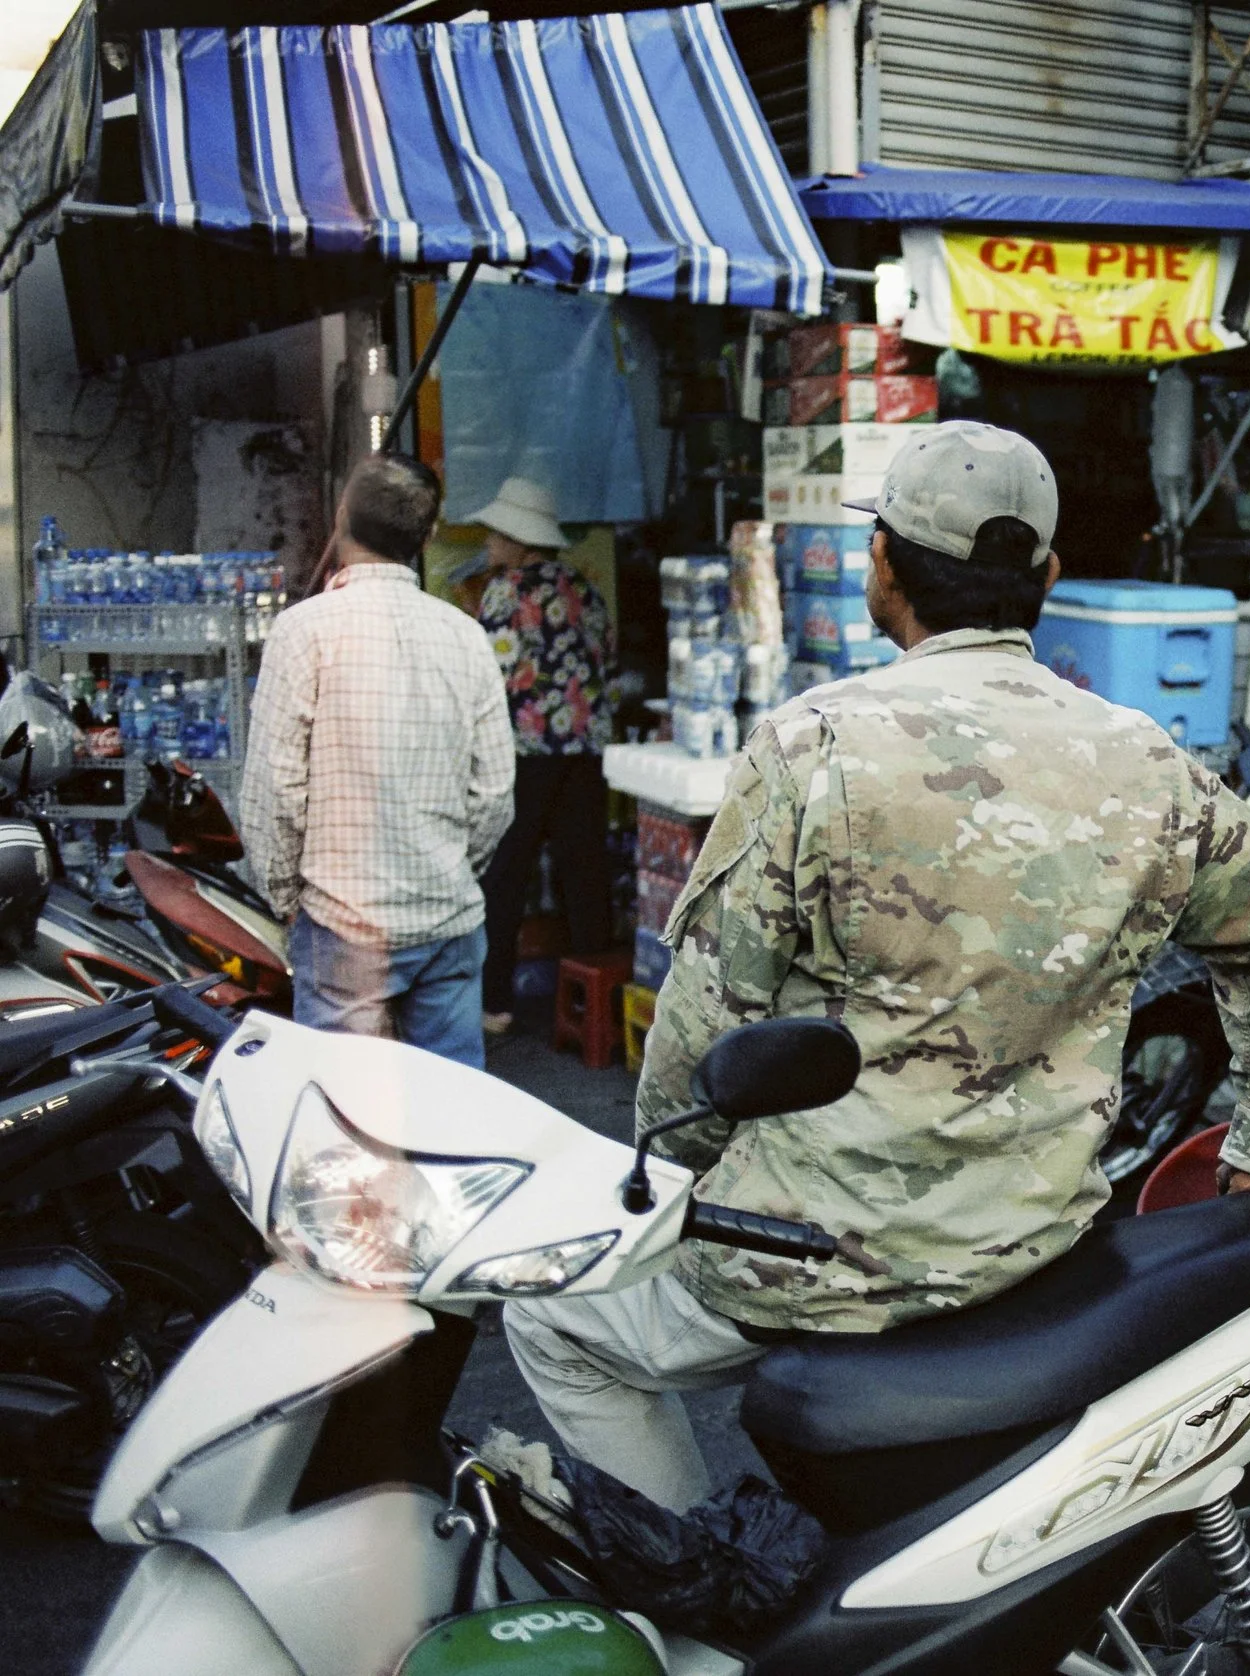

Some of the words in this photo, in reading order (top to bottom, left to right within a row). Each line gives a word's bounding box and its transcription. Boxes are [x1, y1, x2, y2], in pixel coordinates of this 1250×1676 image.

[966, 302, 1085, 349] TRÀ
[1108, 300, 1214, 354] TẮC
[490, 1610, 606, 1642] Grab
